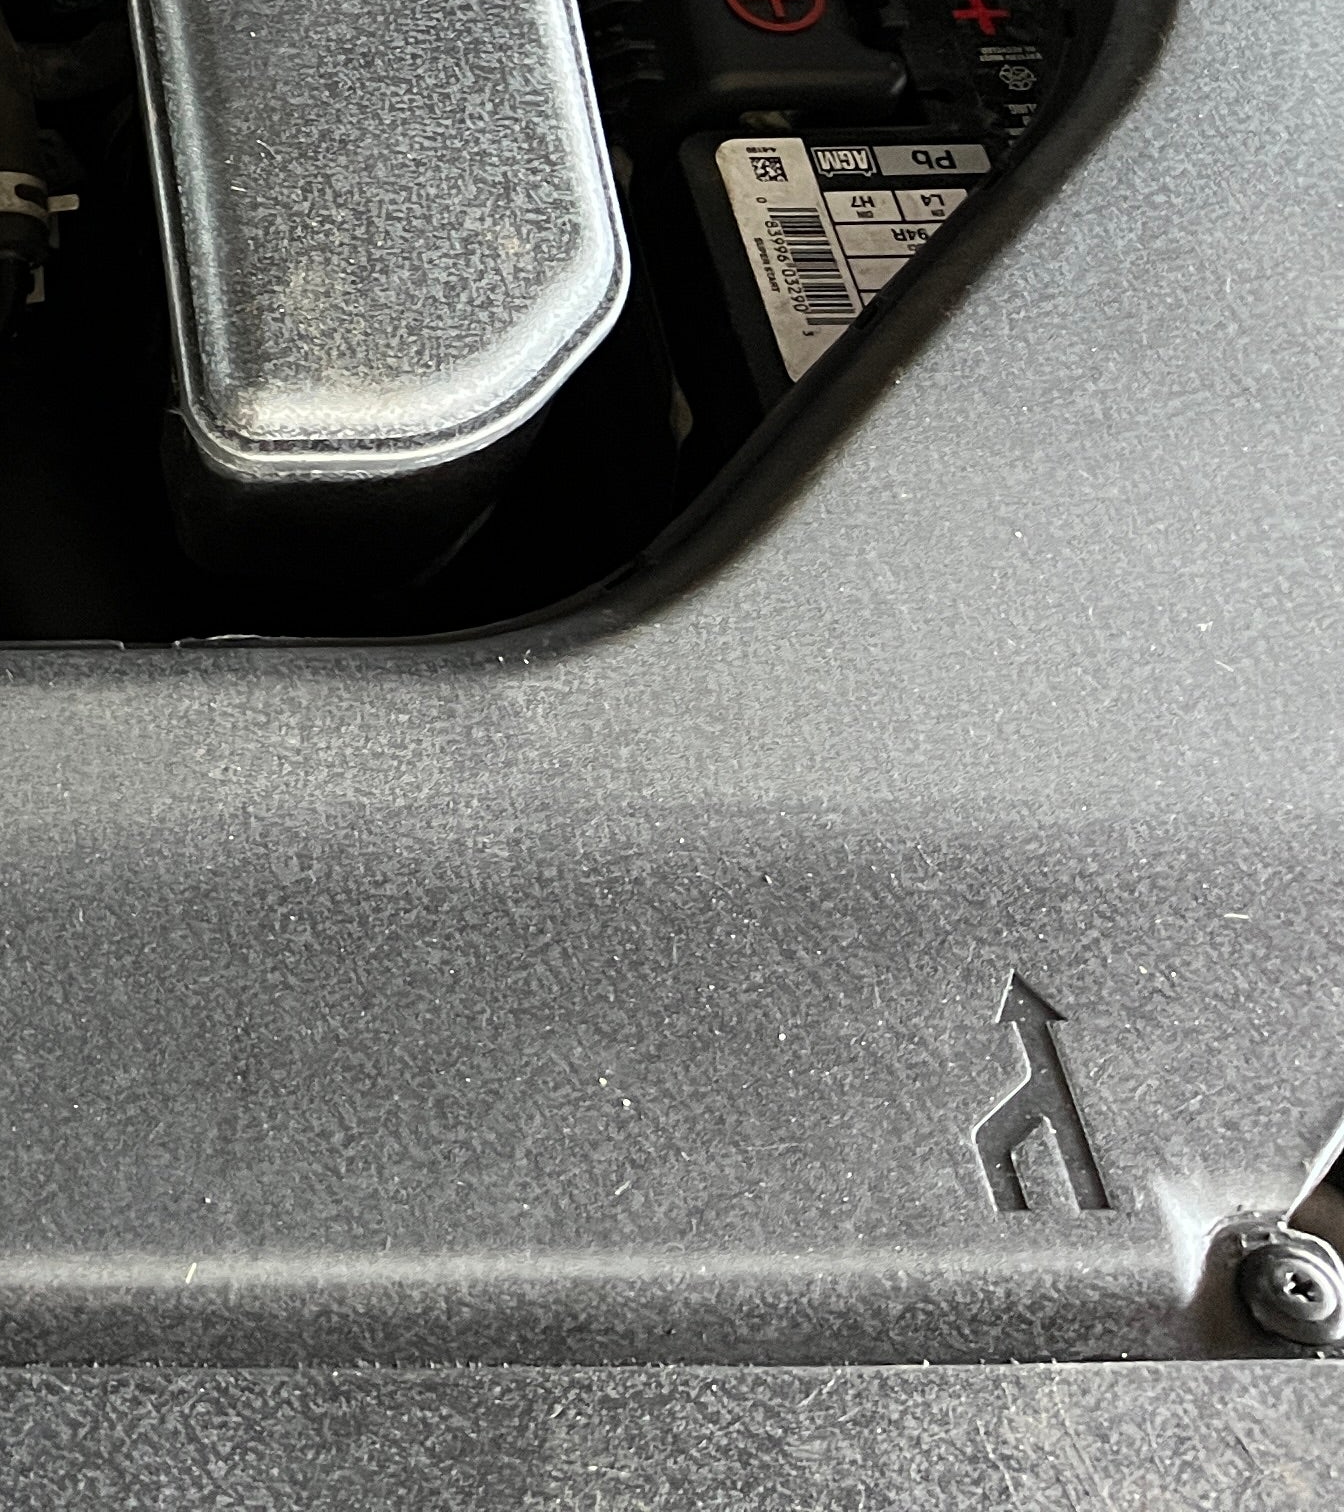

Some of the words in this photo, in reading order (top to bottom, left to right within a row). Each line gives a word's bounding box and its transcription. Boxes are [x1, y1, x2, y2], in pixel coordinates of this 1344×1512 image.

[818, 149, 868, 170] AGM
[911, 149, 957, 170] Pb
[849, 194, 874, 208] H7
[920, 192, 945, 206] L4
[891, 227, 929, 242] 94R
[765, 220, 792, 263] 83996
[782, 267, 809, 313] 03290
